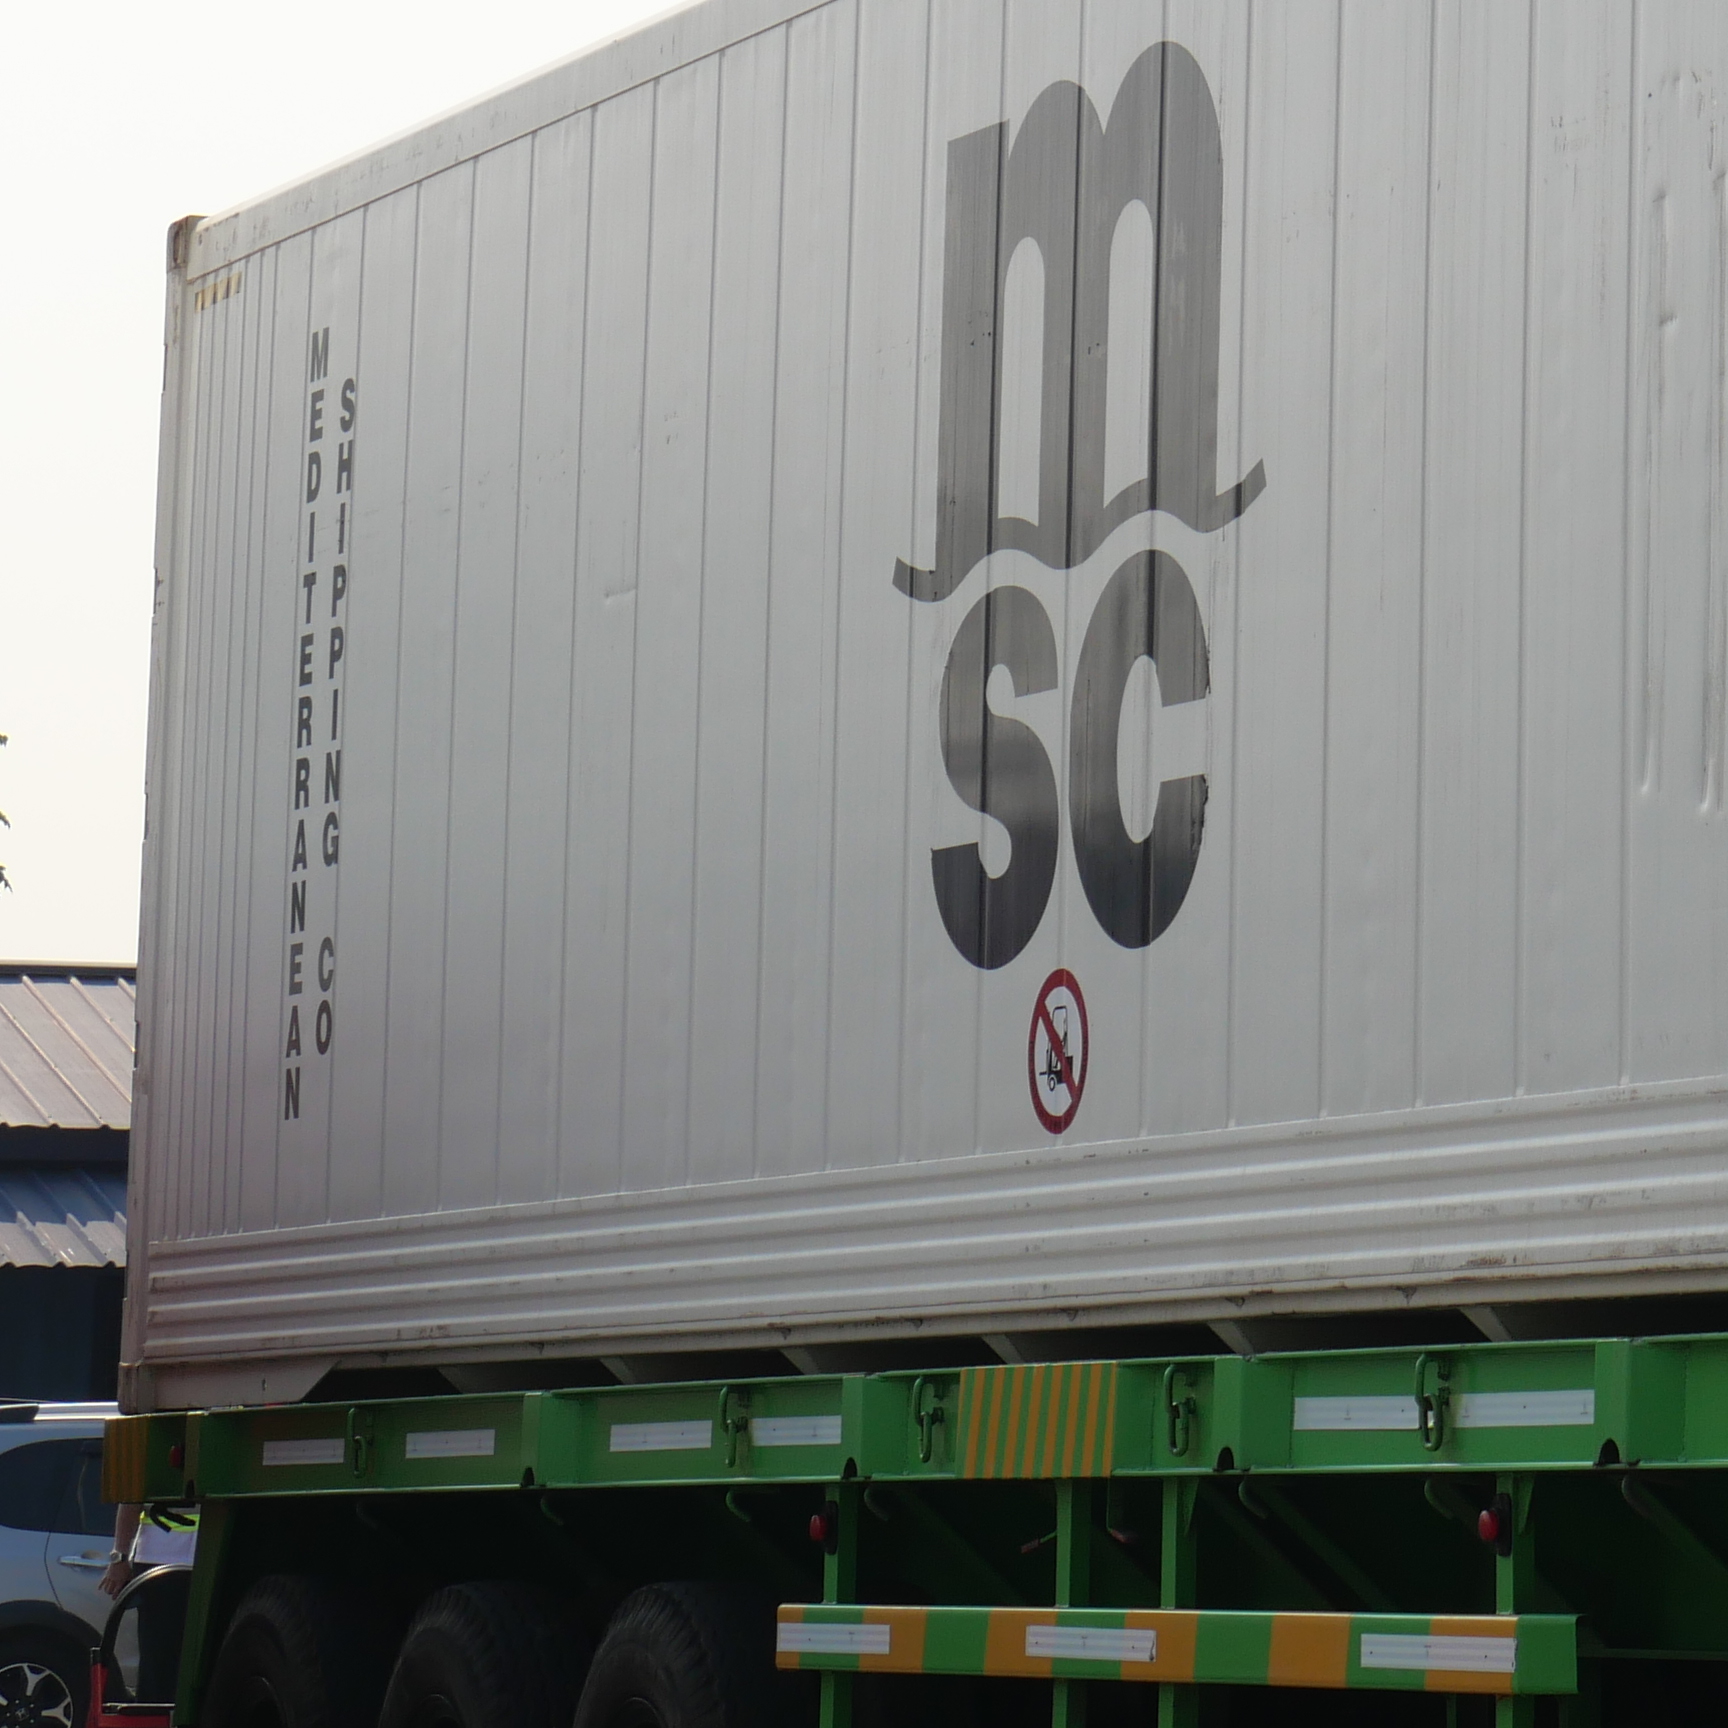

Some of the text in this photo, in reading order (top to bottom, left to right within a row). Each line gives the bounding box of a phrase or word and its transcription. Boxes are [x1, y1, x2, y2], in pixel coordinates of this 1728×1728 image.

[284, 326, 329, 1121] MEDITERRANEAN
[315, 377, 356, 1056] SHIPPING CO
